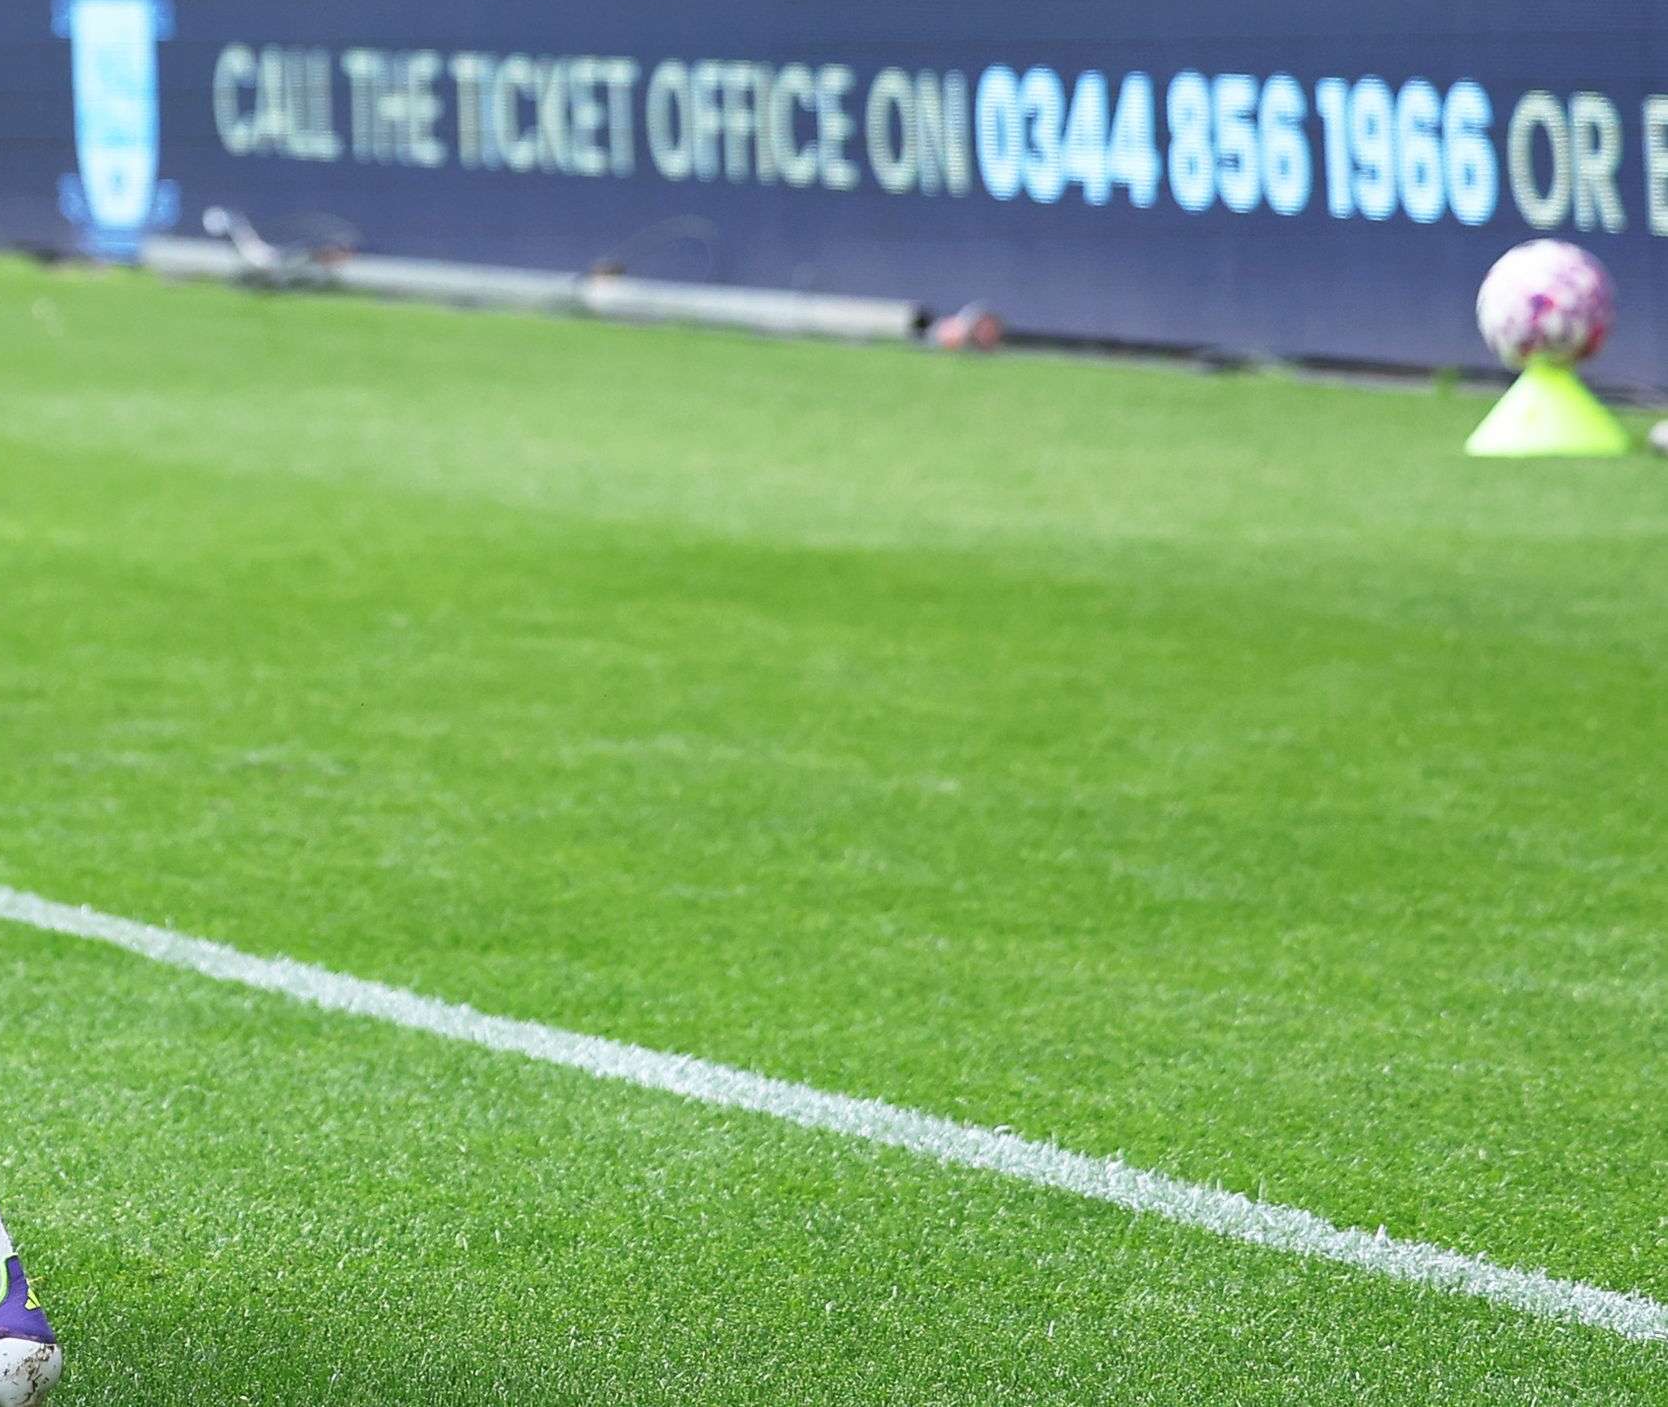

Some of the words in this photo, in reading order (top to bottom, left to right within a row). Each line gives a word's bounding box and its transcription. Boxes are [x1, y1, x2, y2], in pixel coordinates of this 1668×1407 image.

[214, 43, 343, 161] CALL
[341, 49, 447, 167] THE
[447, 51, 640, 176] TICKET
[646, 57, 860, 192] OFFICE
[866, 66, 969, 196] ON
[975, 64, 1161, 208] 0344
[1167, 69, 1311, 216] 856
[1316, 75, 1498, 226] 1966
[1508, 90, 1628, 234] OR
